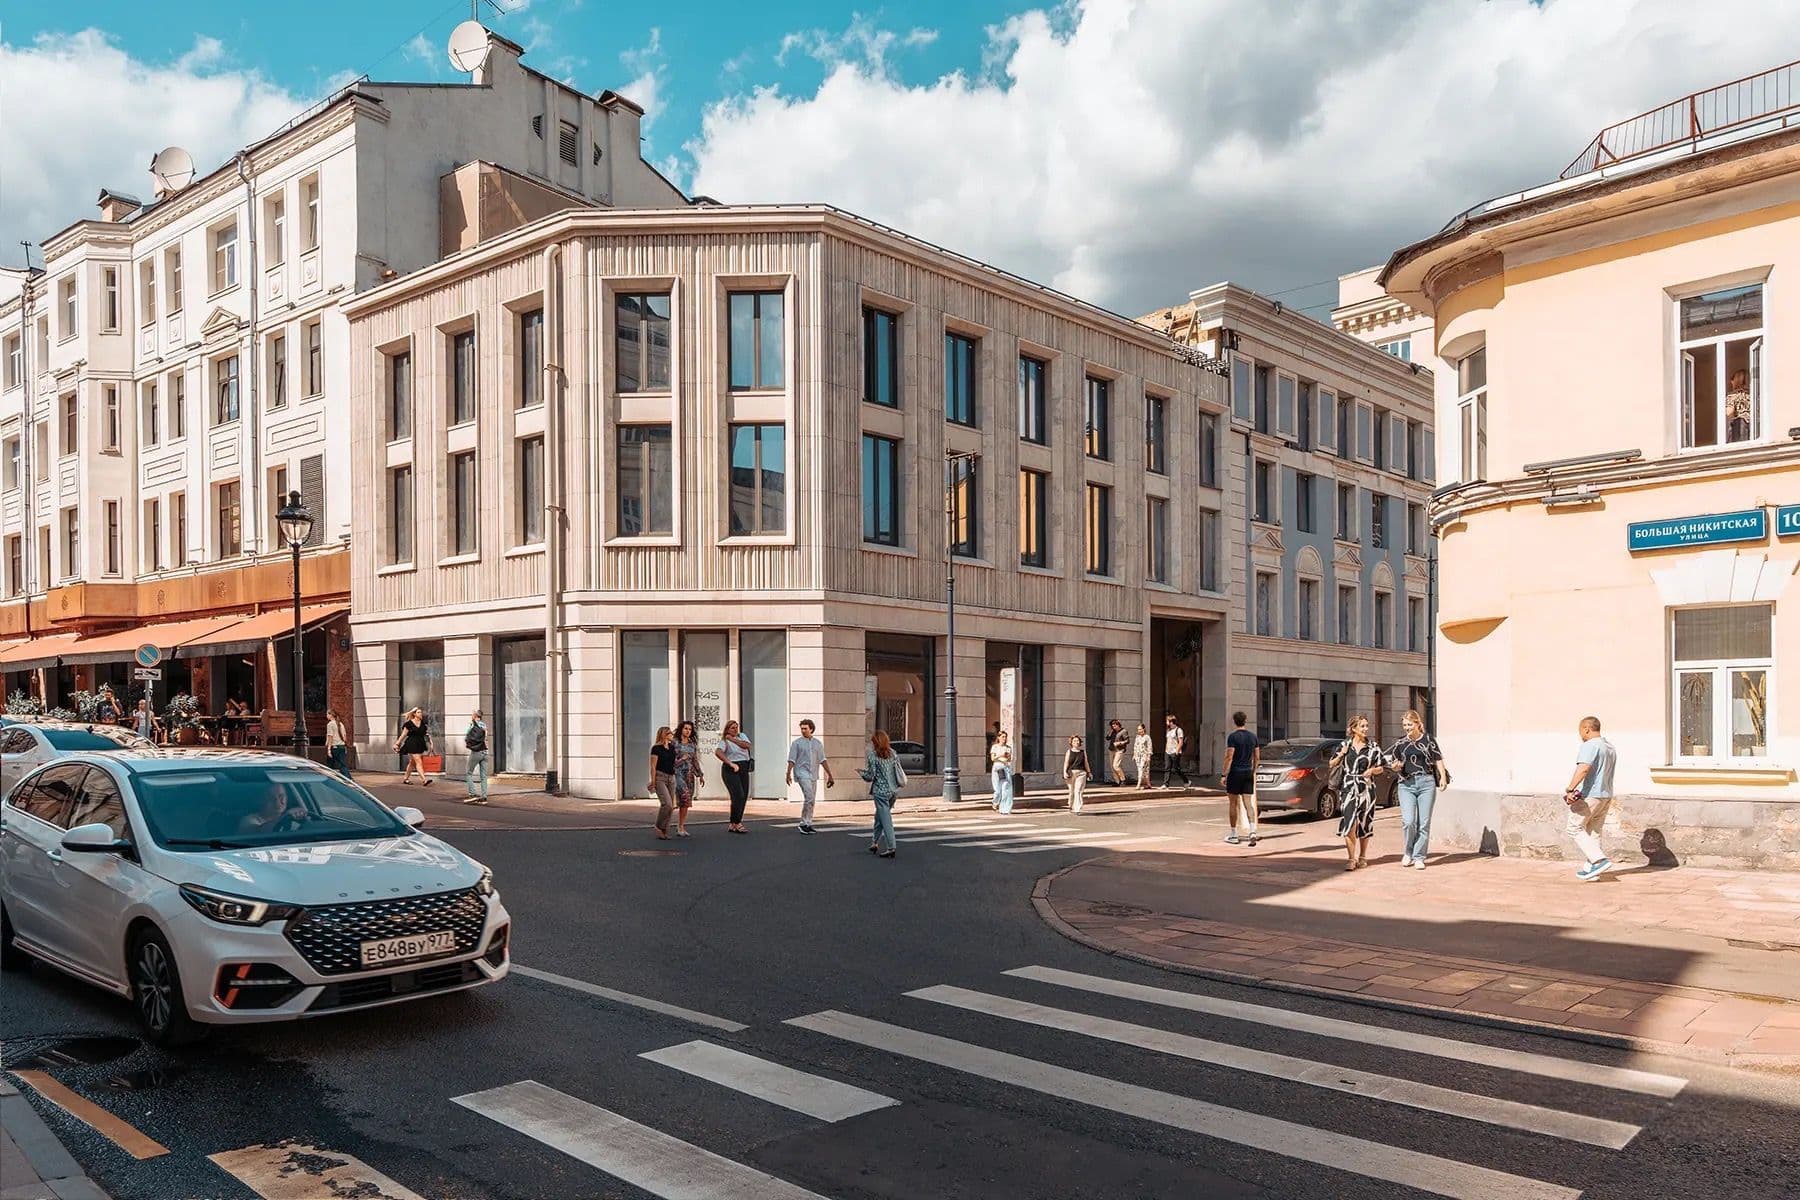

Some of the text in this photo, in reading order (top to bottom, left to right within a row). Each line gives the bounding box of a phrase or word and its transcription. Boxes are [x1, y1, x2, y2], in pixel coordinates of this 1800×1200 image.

[1635, 517, 1757, 538] БОЛЬШАЯ НИКИТСКАЯ
[1680, 533, 1709, 541] УЛИЦА
[695, 691, 720, 701] R4S
[428, 932, 450, 947] 977
